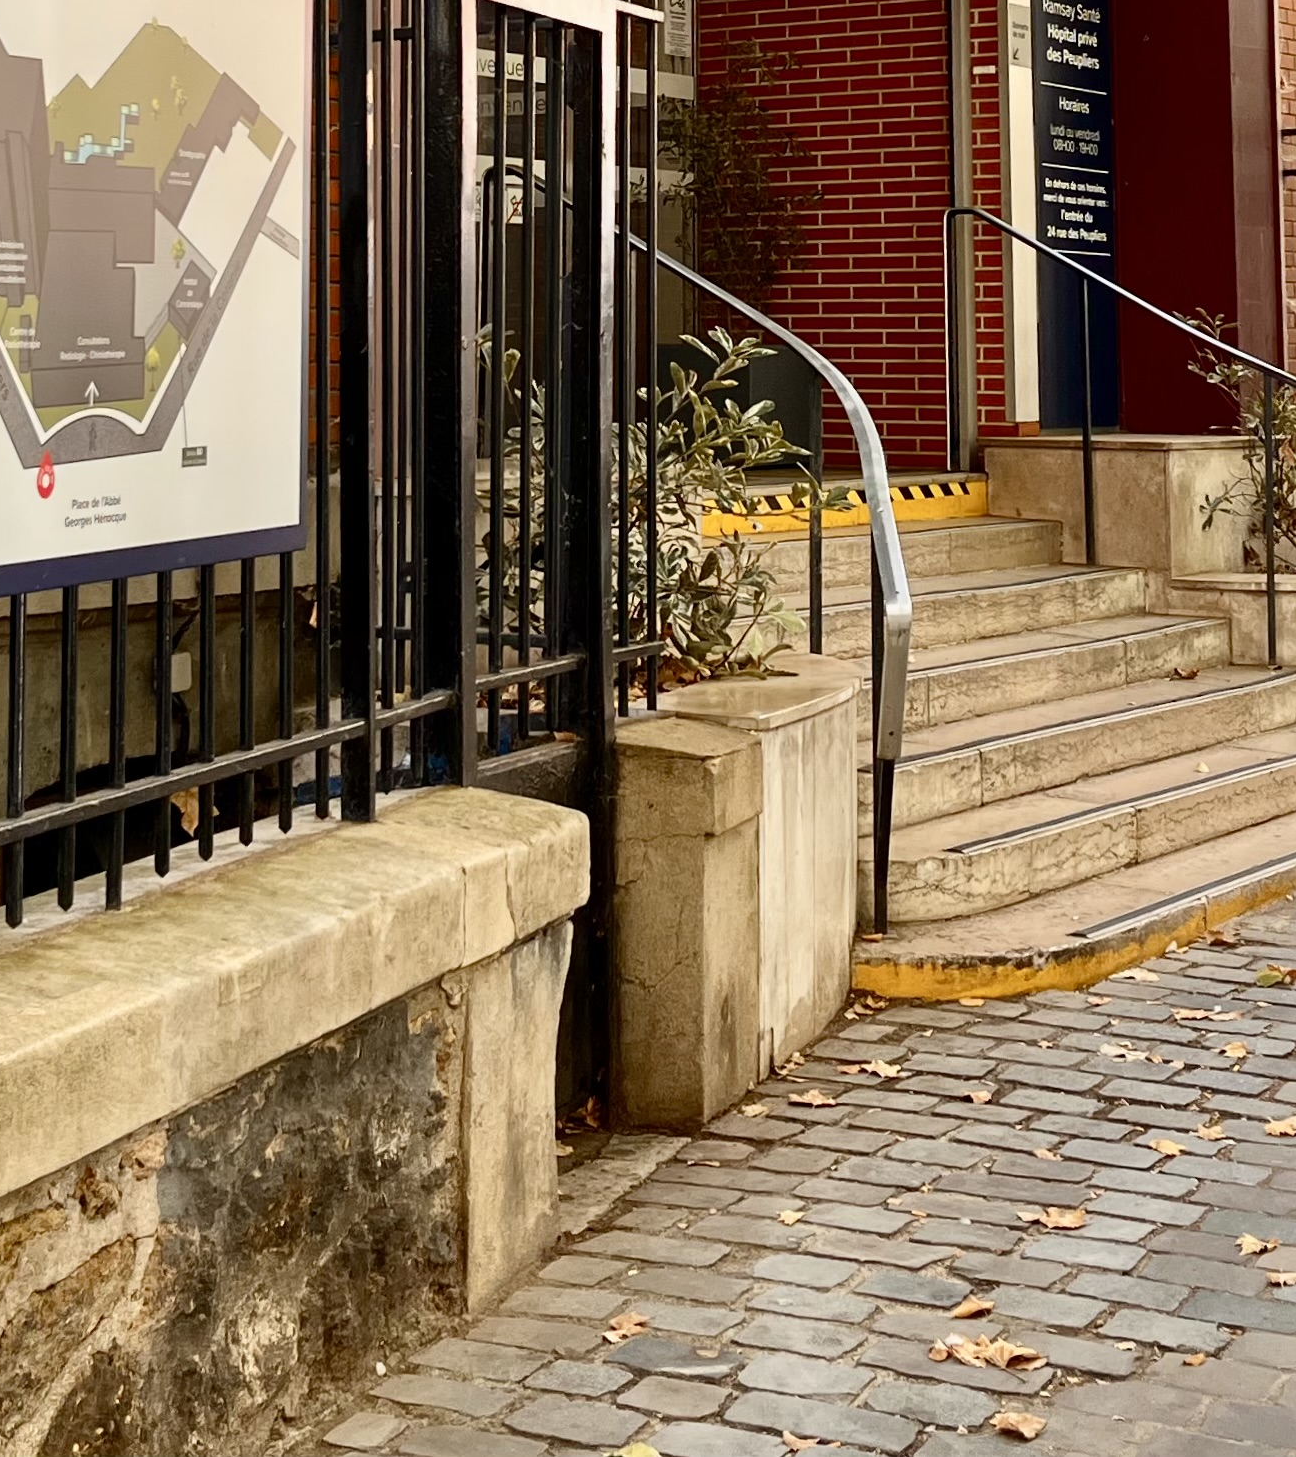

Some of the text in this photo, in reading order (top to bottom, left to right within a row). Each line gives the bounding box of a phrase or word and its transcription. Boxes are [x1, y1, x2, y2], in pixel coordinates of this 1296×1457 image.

[1077, 3, 1101, 24] Santé
[1047, 23, 1098, 48] Hôpital privé
[1046, 46, 1100, 70] des Peupliers
[1059, 96, 1090, 114] Horaires
